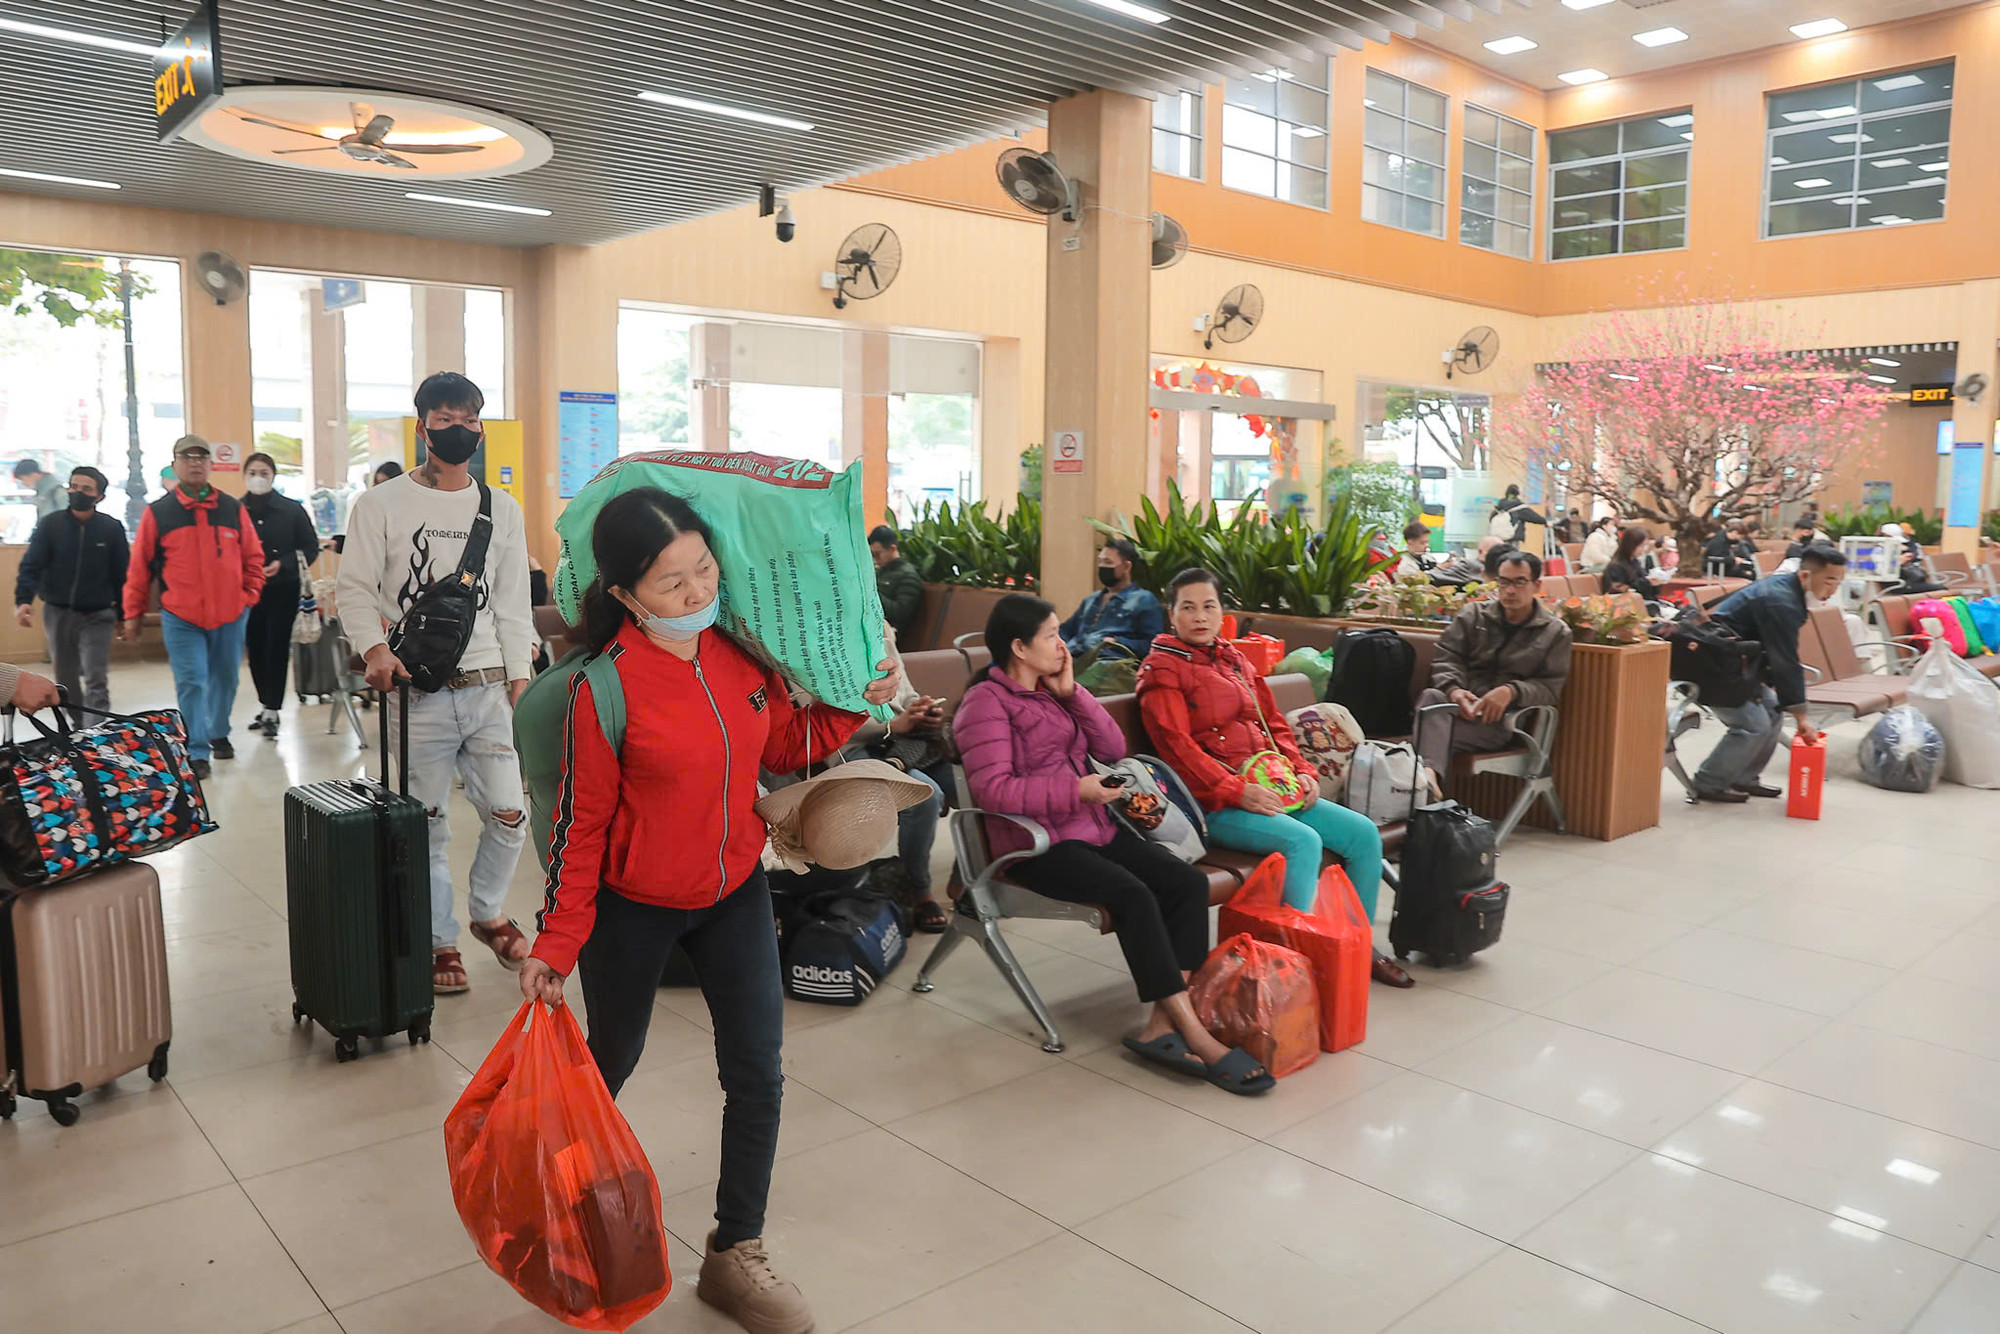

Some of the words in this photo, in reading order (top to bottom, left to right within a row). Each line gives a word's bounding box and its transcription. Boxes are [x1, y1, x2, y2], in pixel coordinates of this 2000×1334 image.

[155, 62, 179, 116] EXIT
[1912, 388, 1949, 401] EXIT
[679, 454, 692, 463] 22
[563, 539, 574, 570] CNH
[570, 572, 581, 600] HOÀN
[792, 965, 854, 983] adidas
